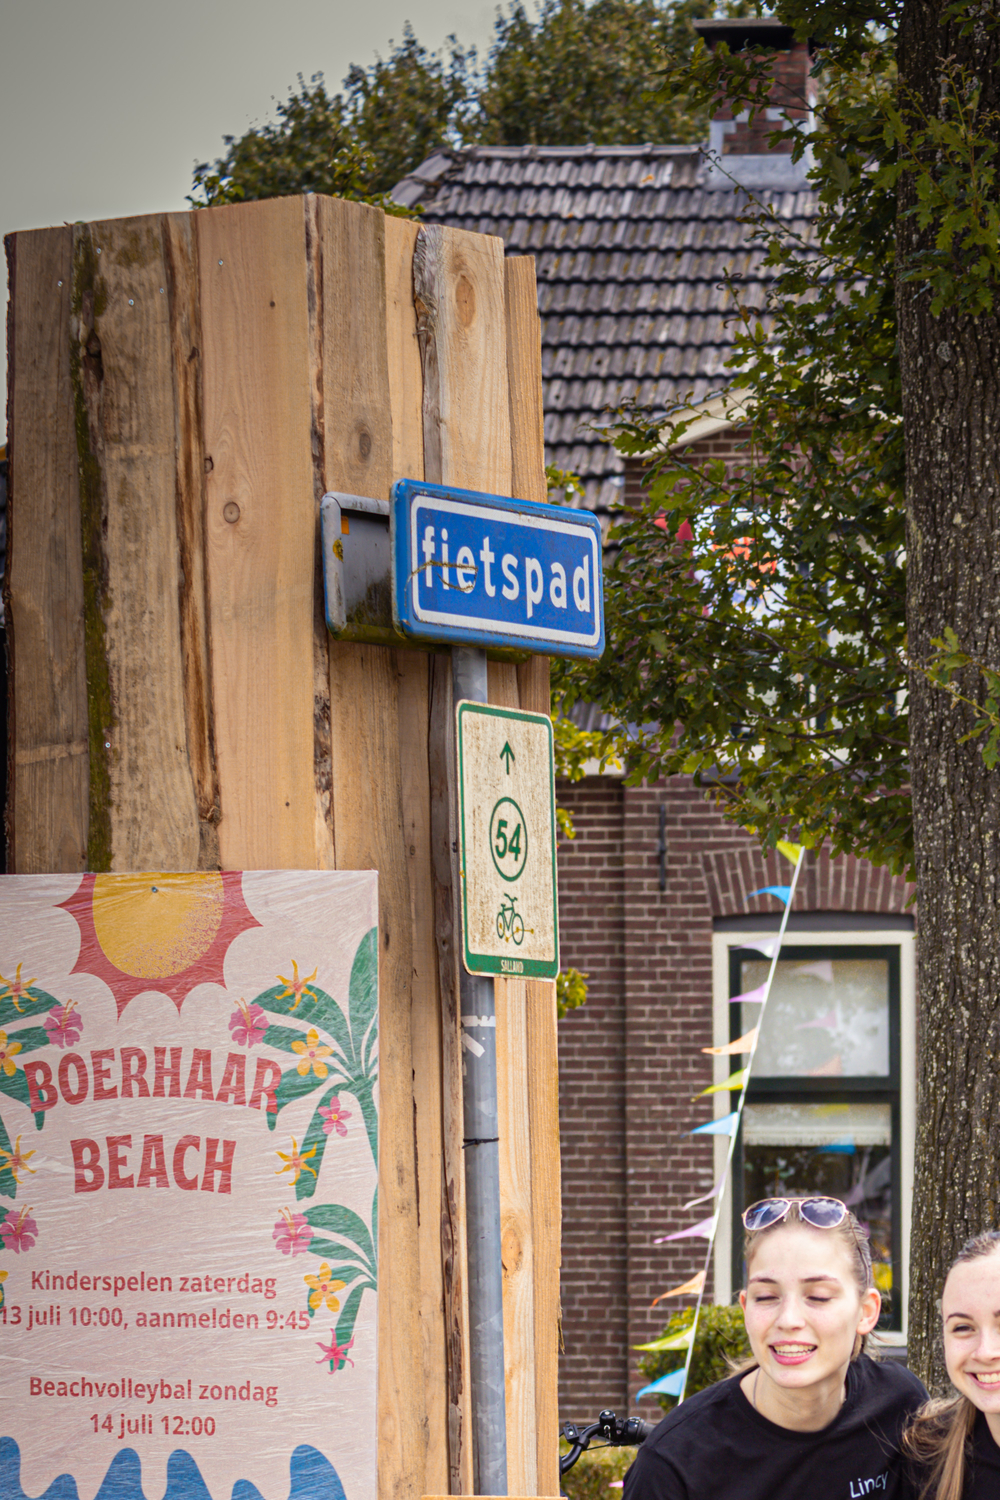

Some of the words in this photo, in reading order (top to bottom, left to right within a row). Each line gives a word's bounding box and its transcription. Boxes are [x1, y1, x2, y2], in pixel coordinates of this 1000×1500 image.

[422, 525, 591, 619] fietspad
[495, 819, 521, 861] 54
[23, 1046, 283, 1115] BOERHAAR
[69, 1134, 237, 1195] BEACH
[31, 1270, 173, 1297] Kinderspelen
[179, 1272, 277, 1299] zaterdag
[0, 1306, 22, 1325] 13
[26, 1305, 61, 1331] juli
[68, 1307, 129, 1331] 10:00,
[135, 1308, 259, 1330] aanmelden
[266, 1309, 311, 1331] 9:45
[29, 1376, 192, 1404] Beachvolleybal
[198, 1381, 279, 1407] zondag
[90, 1413, 114, 1433] 14
[118, 1413, 153, 1439] juli
[160, 1416, 216, 1436] 12:00
[849, 1470, 889, 1498] Lincy
